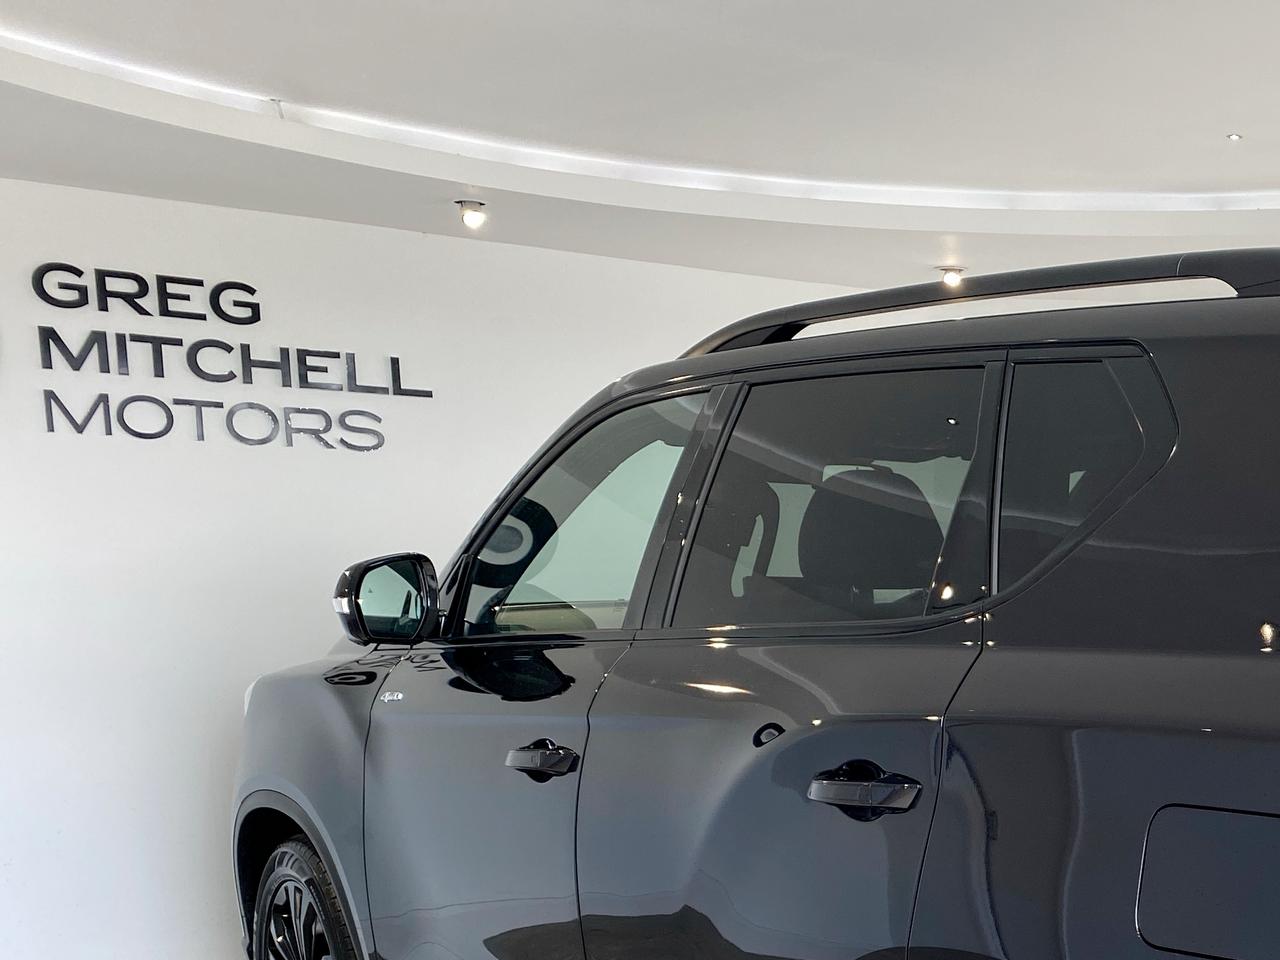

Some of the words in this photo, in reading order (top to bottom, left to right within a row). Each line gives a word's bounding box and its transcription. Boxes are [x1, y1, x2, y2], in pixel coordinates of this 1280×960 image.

[31, 261, 261, 325] GREG
[37, 325, 434, 398] MITCHELL
[43, 389, 386, 452] MOTORS
